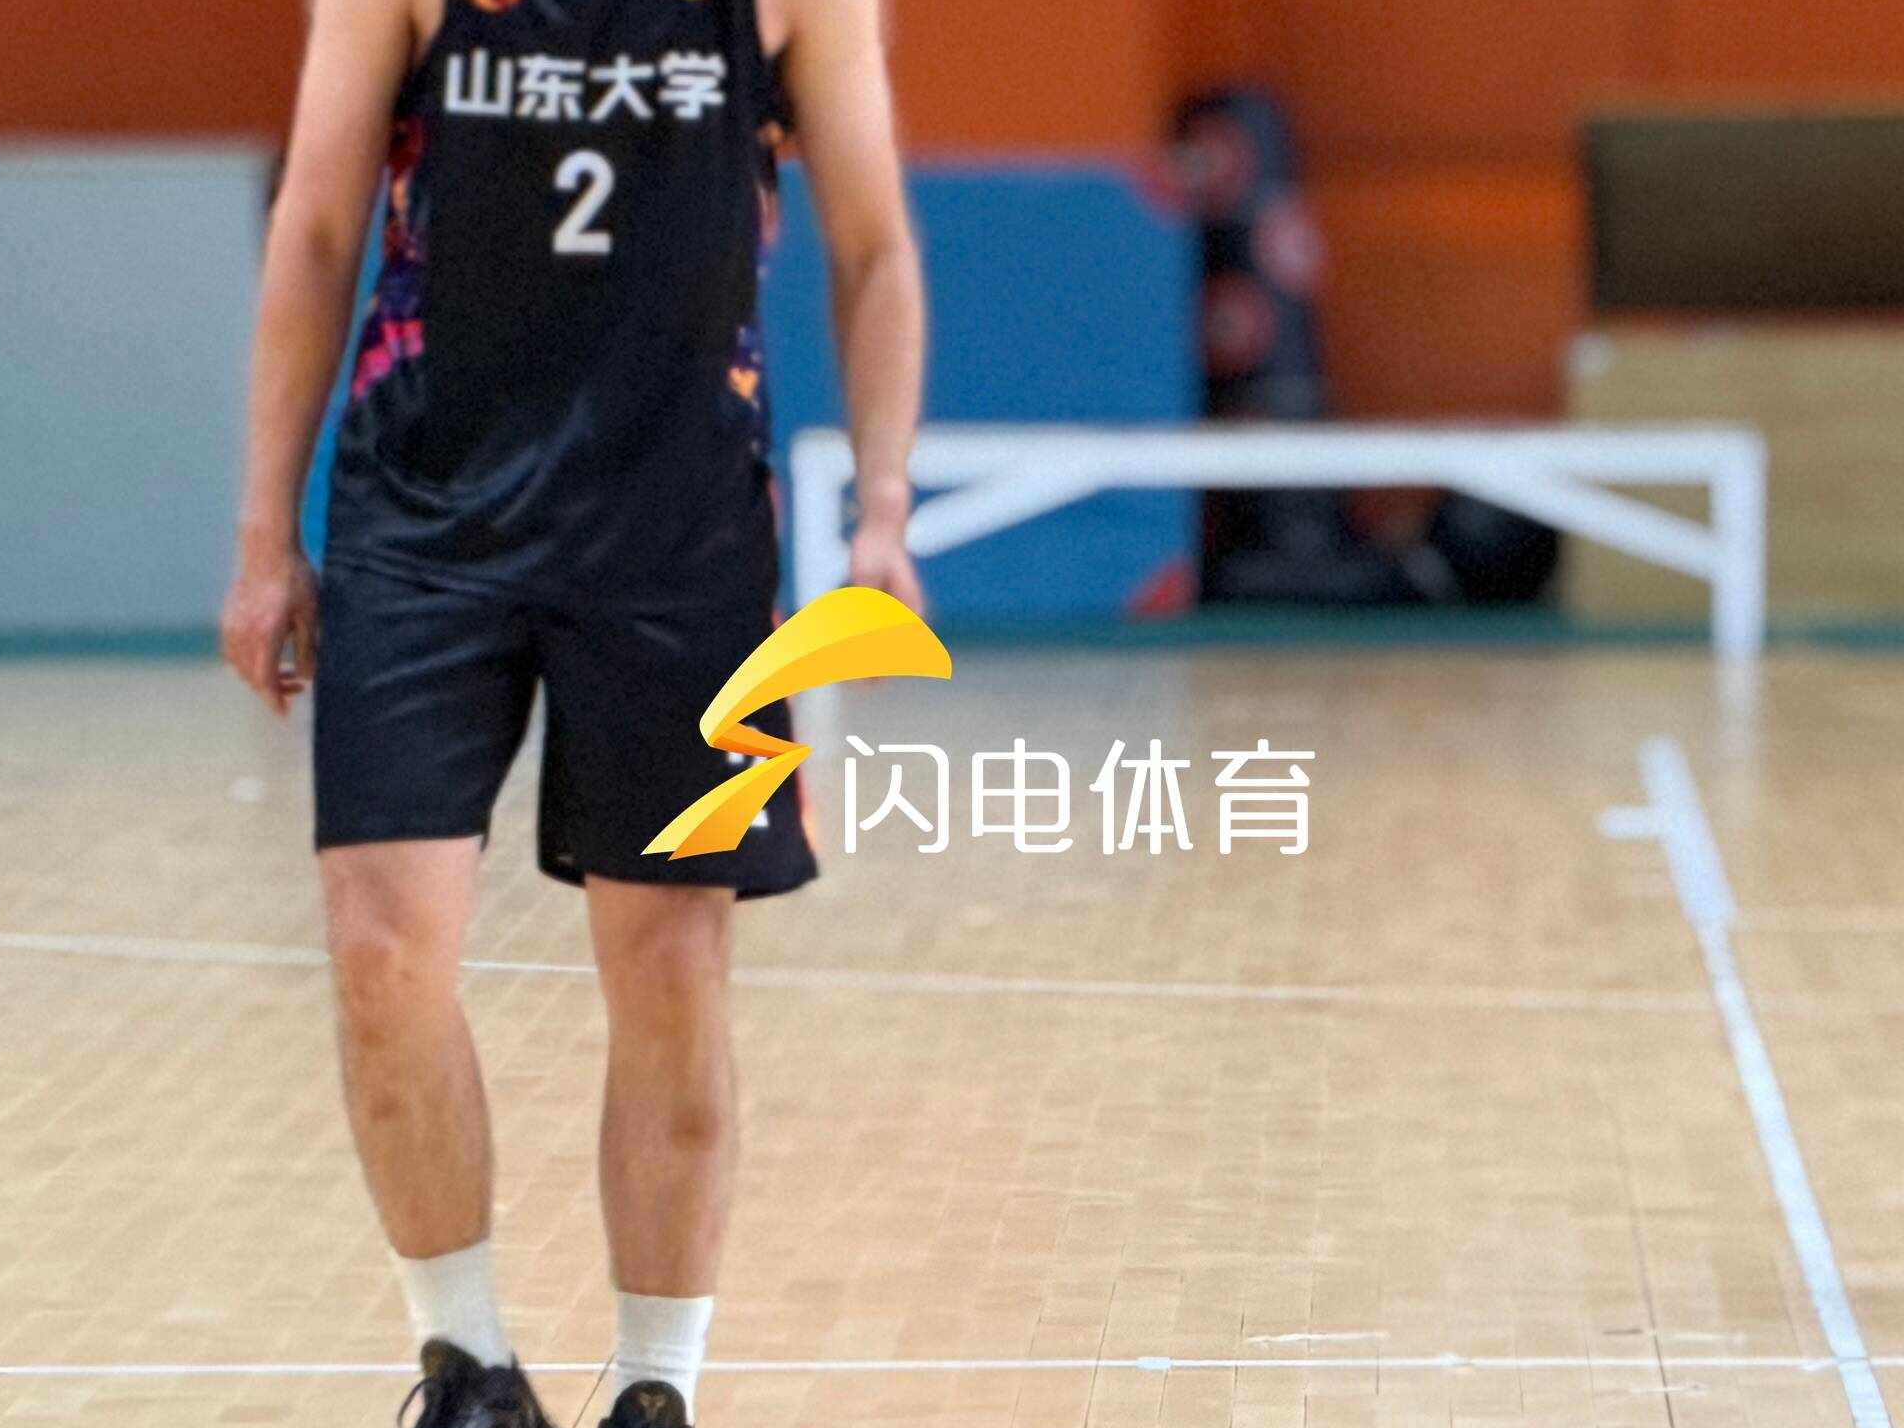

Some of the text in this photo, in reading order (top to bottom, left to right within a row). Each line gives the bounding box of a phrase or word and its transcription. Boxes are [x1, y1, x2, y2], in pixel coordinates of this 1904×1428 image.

[443, 49, 727, 121] 山东大学
[551, 150, 615, 255] 2
